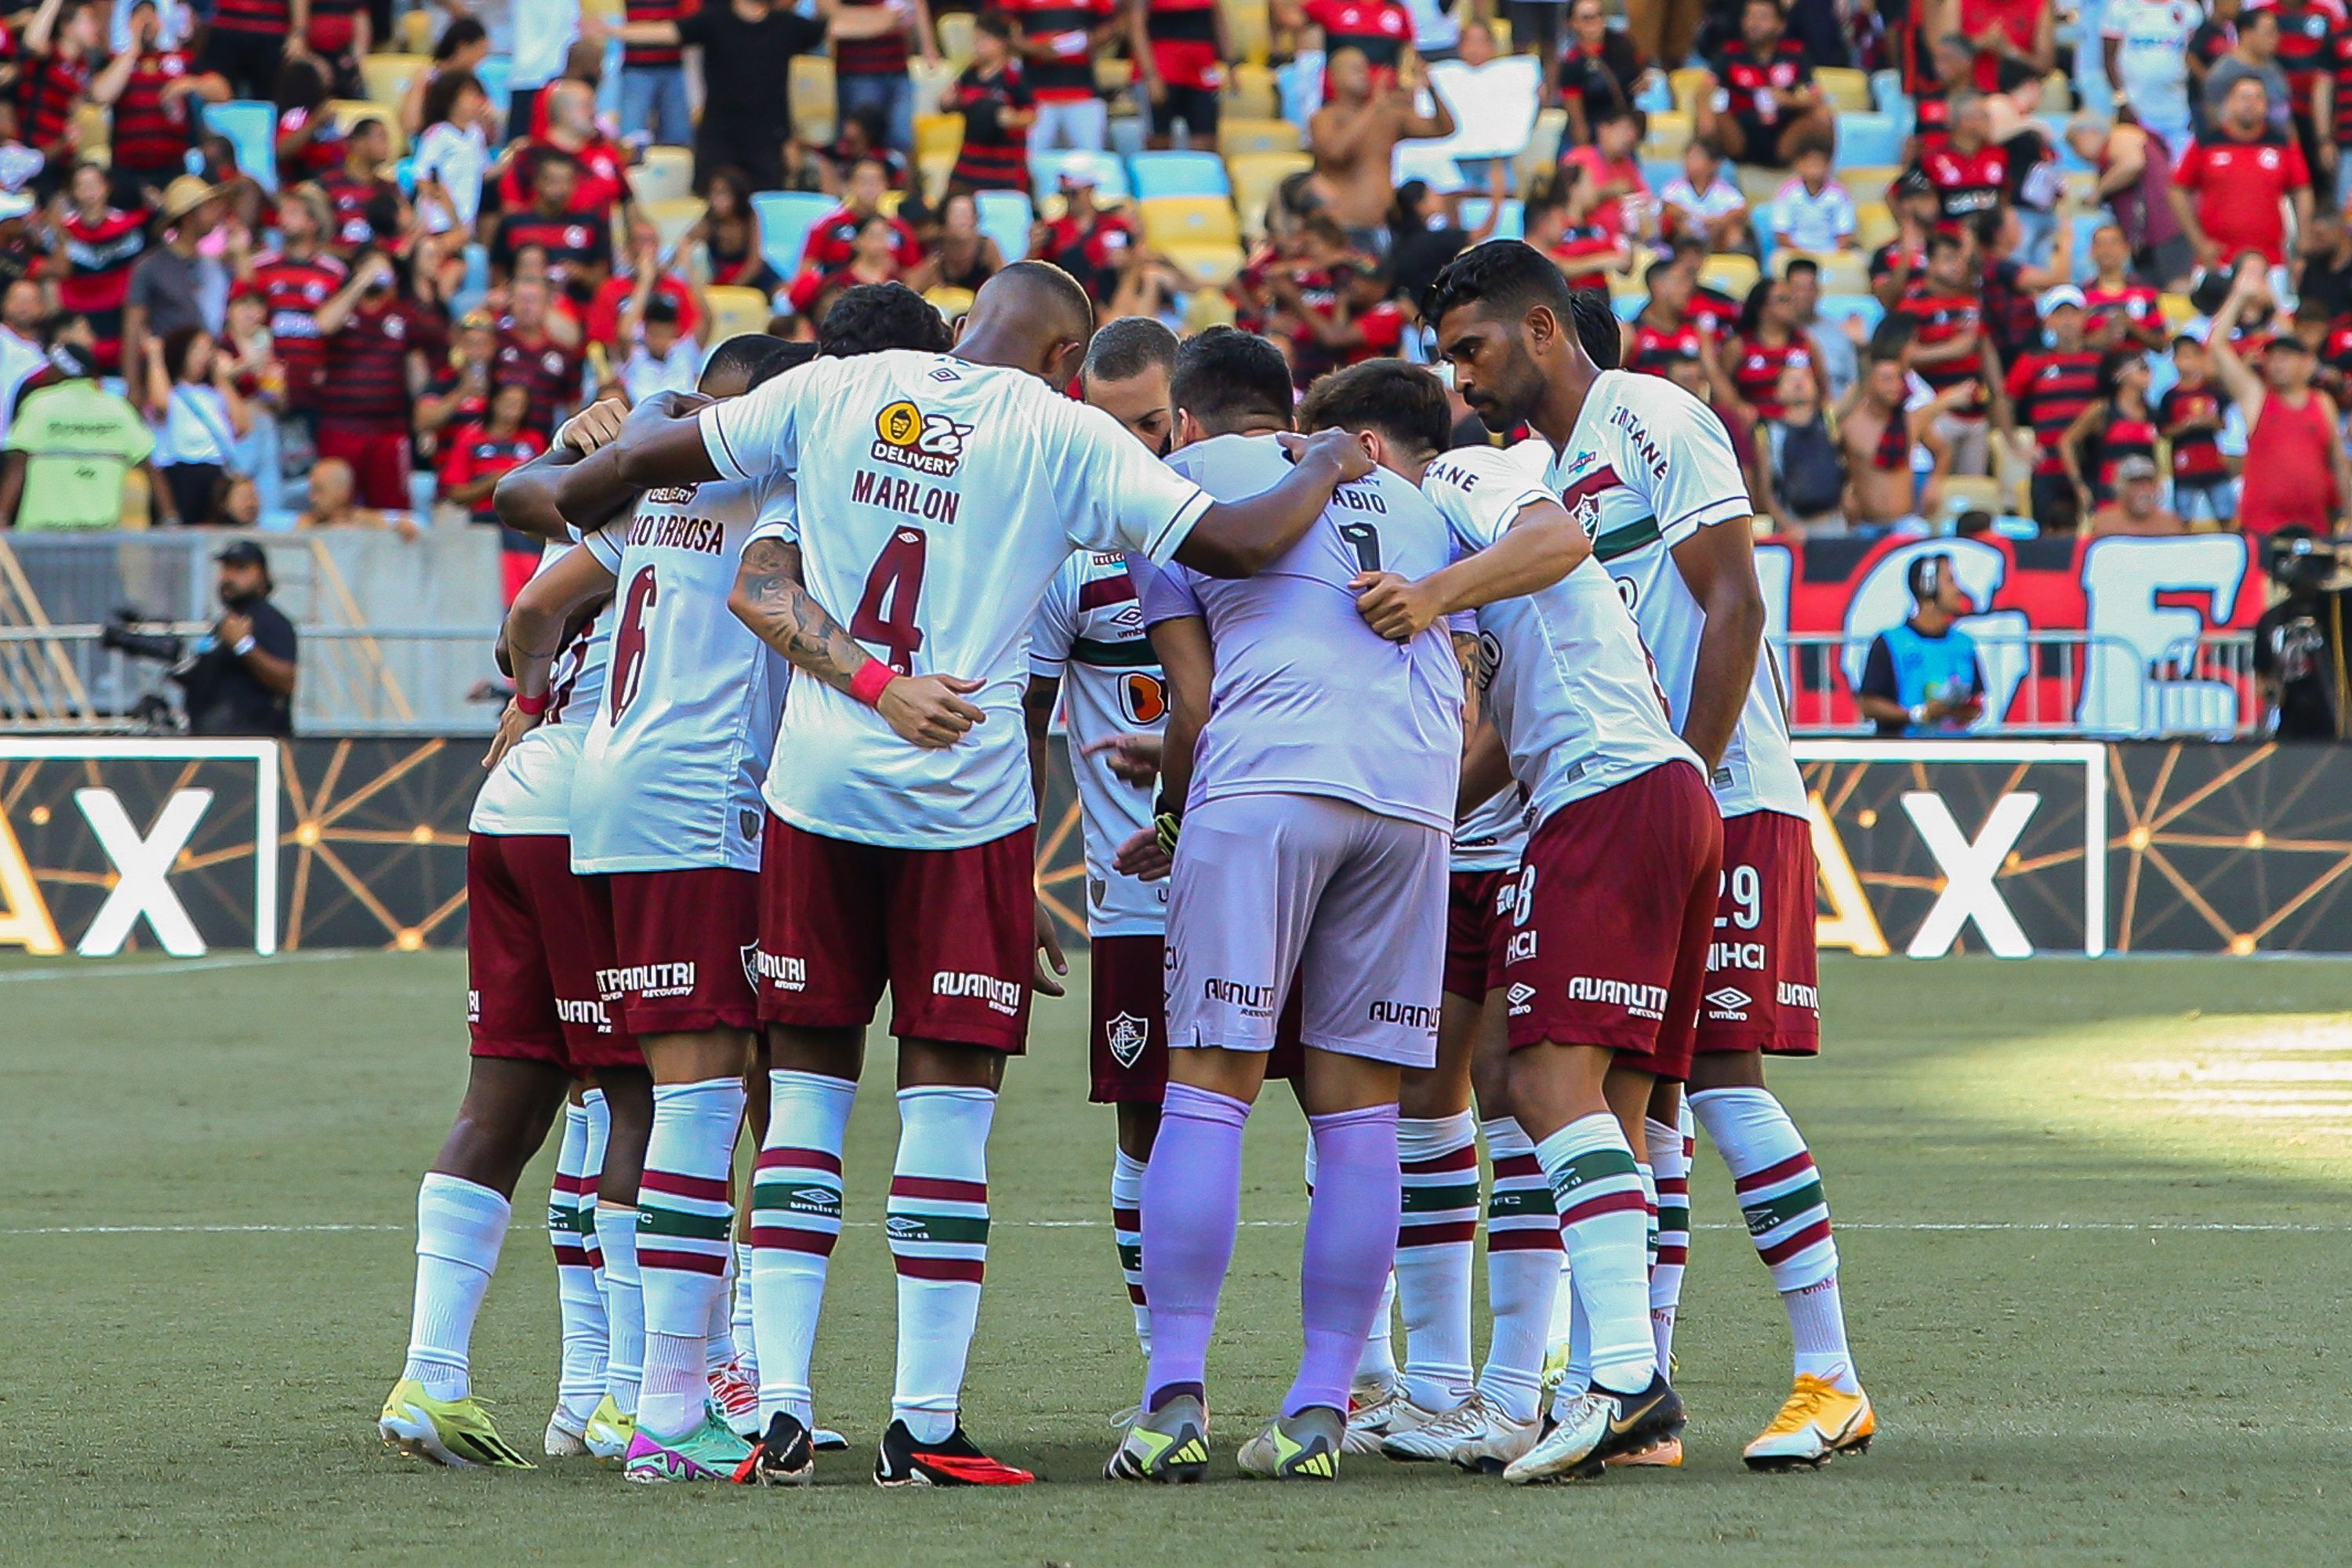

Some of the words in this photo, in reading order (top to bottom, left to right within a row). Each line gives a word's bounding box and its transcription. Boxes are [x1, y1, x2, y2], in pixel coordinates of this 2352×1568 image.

[873, 442, 956, 474] DELIVERY
[851, 470, 960, 524] MARLON
[850, 526, 927, 676] 4
[611, 564, 656, 728] 6
[1513, 864, 1537, 927] 8
[1721, 942, 1765, 971] HCI
[1708, 1010, 1748, 1022] umbro
